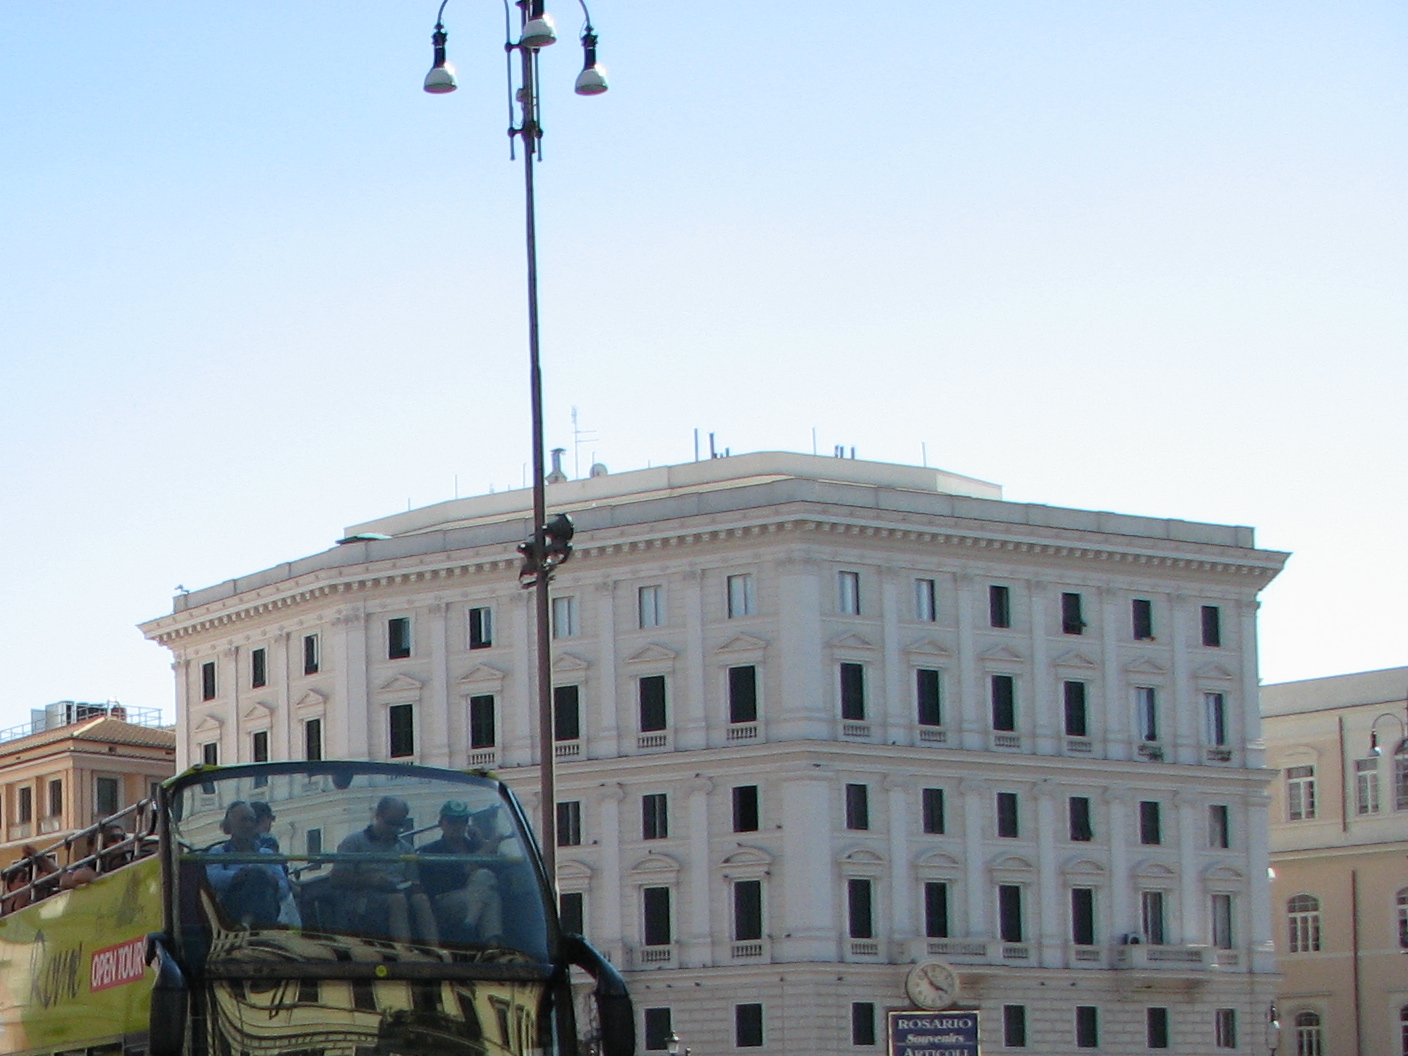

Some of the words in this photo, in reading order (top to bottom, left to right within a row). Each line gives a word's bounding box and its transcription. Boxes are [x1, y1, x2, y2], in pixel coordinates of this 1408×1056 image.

[92, 949, 116, 987] OPEN
[117, 940, 144, 980] TOUR
[897, 1018, 972, 1030] ROSARIO
[905, 1032, 965, 1045] Souvenirs
